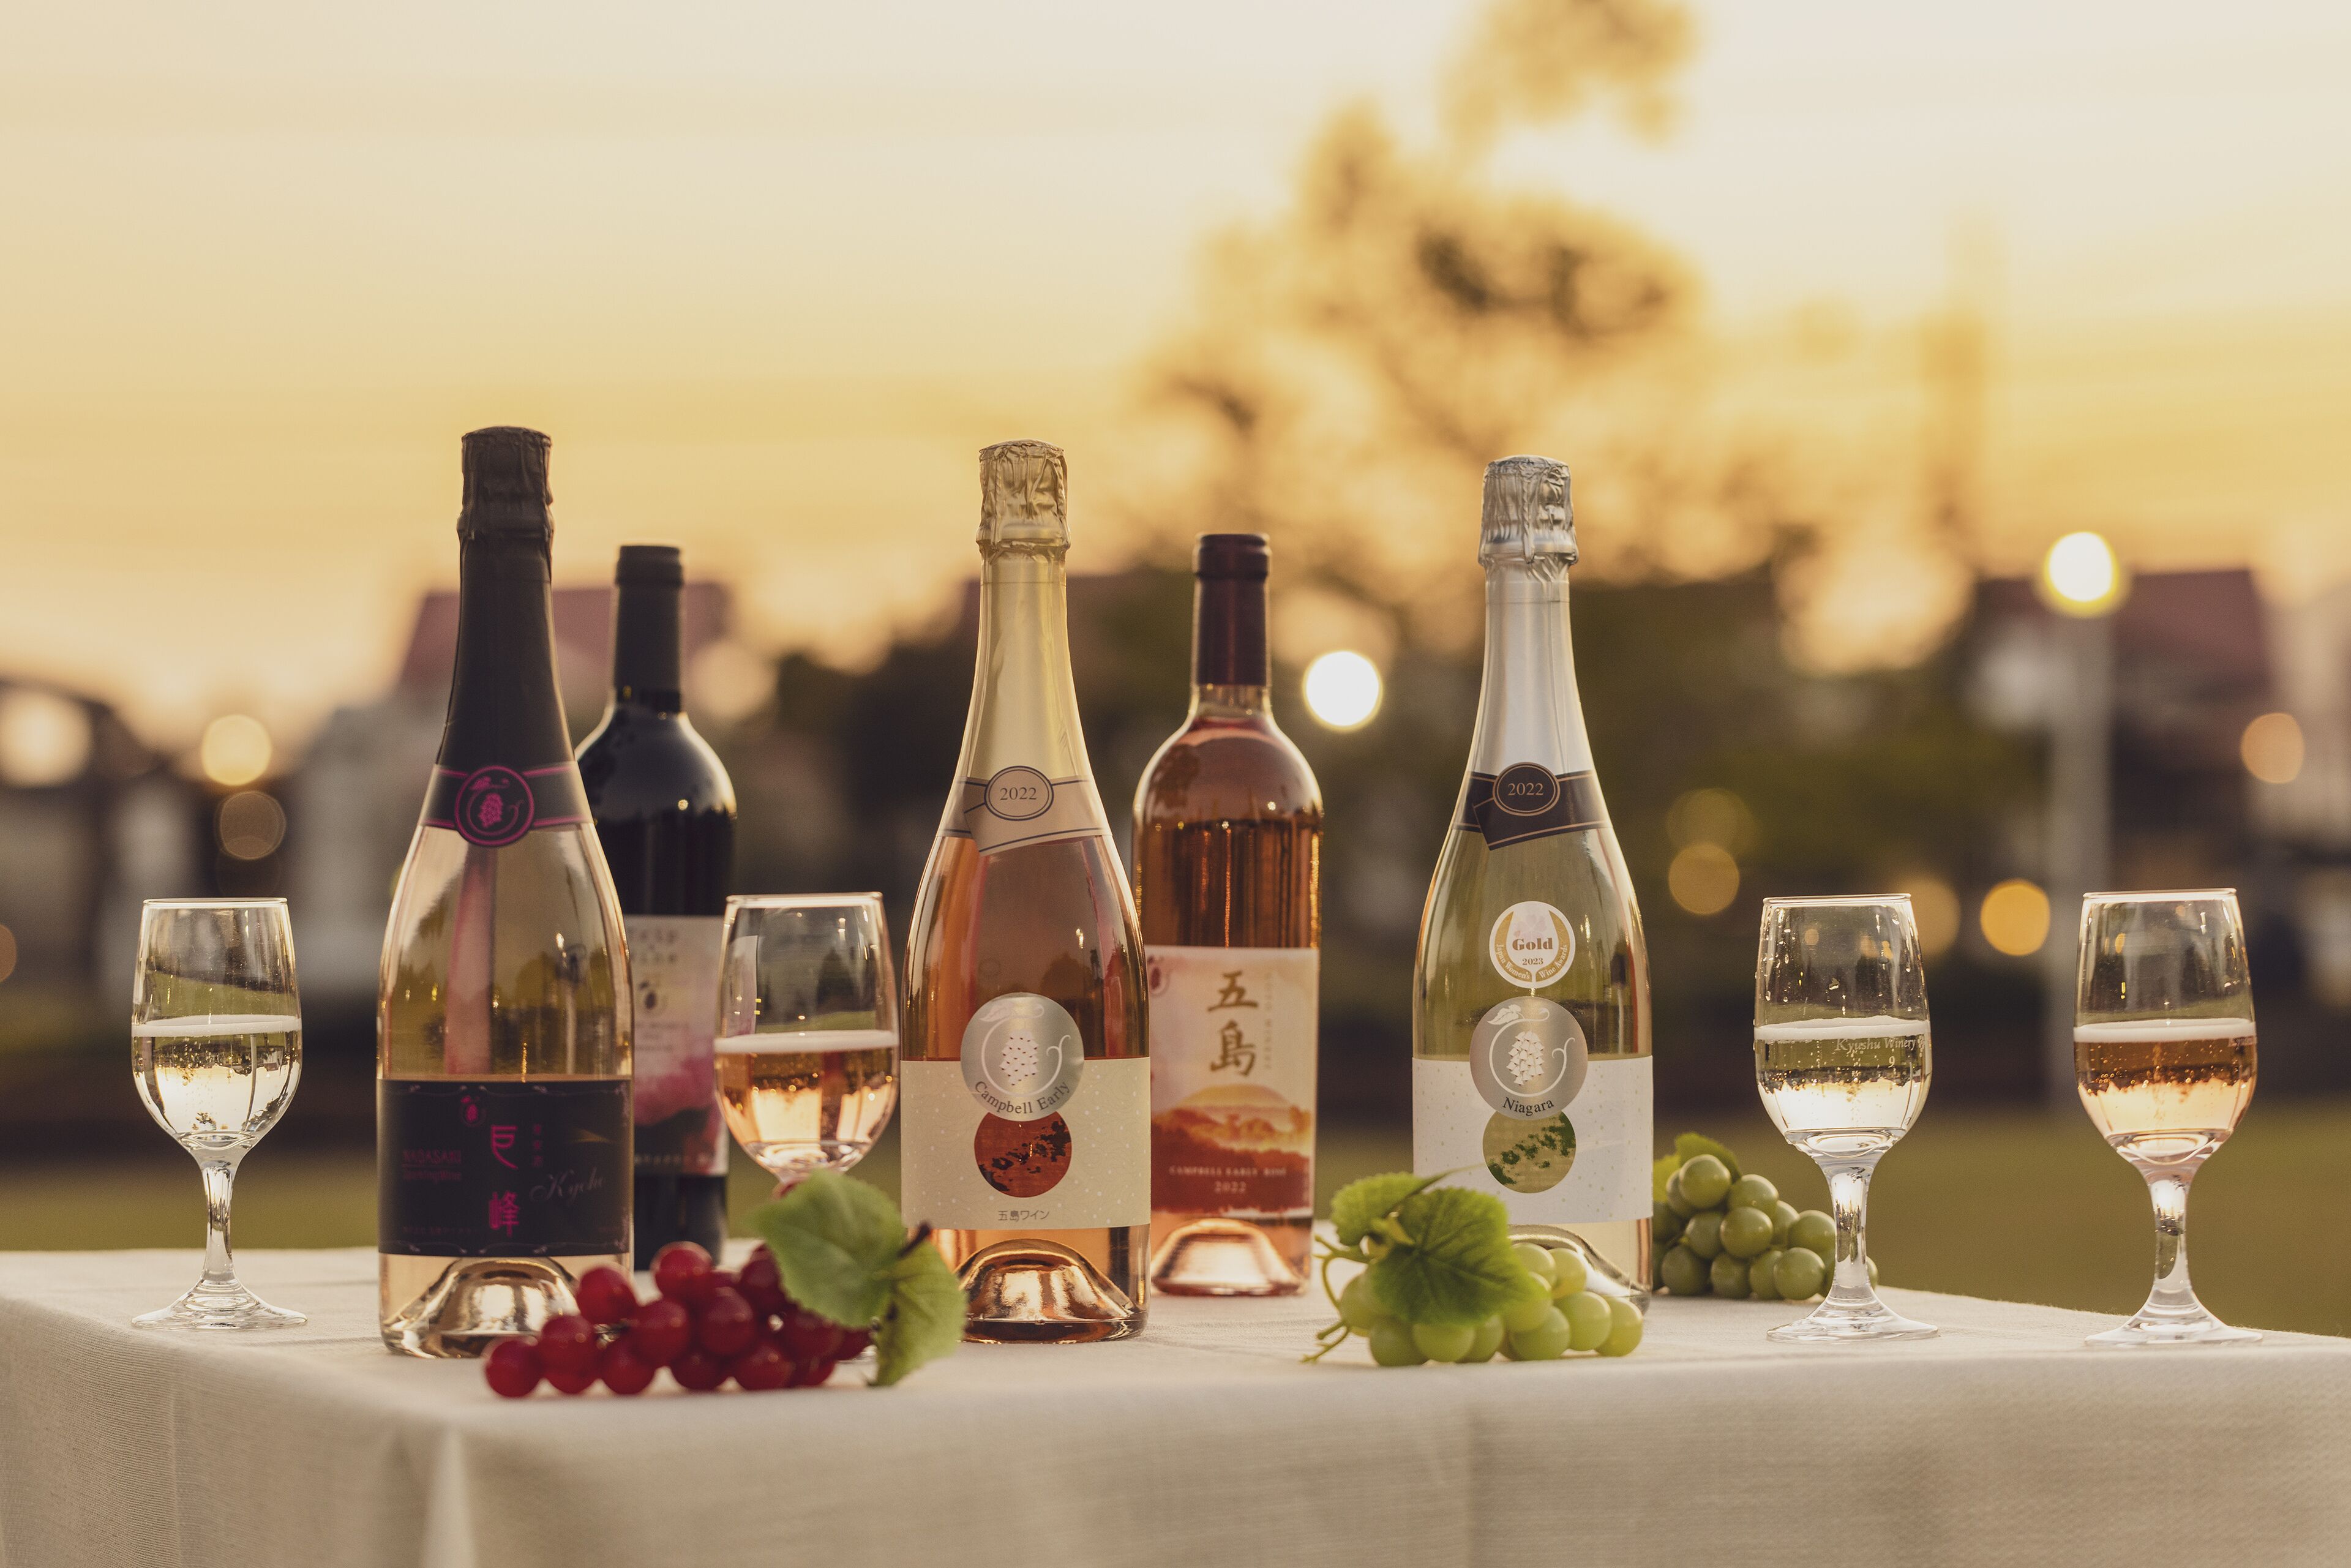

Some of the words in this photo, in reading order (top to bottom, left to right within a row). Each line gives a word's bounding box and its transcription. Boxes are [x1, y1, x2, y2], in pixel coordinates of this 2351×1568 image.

[999, 787, 1037, 801] 2022
[1508, 782, 1544, 796] 2022
[1512, 937, 1553, 951] Gold
[1496, 943, 1506, 964] Japan
[1505, 961, 1531, 980] Women's
[1537, 967, 1556, 979] Wine
[1554, 943, 1568, 969] Awards
[1207, 969, 1258, 1077] 五島
[1834, 1038, 1881, 1055] Kyushu
[1884, 1037, 1916, 1051] Winery
[1888, 1056, 1896, 1068] 9
[975, 1081, 1033, 1114] Campbell
[1037, 1082, 1070, 1111] Early
[1502, 1097, 1554, 1117] Niagara
[489, 1124, 520, 1237] 巨峰
[1214, 1180, 1247, 1193] 2022
[998, 1210, 1049, 1223] 五島ワイン
